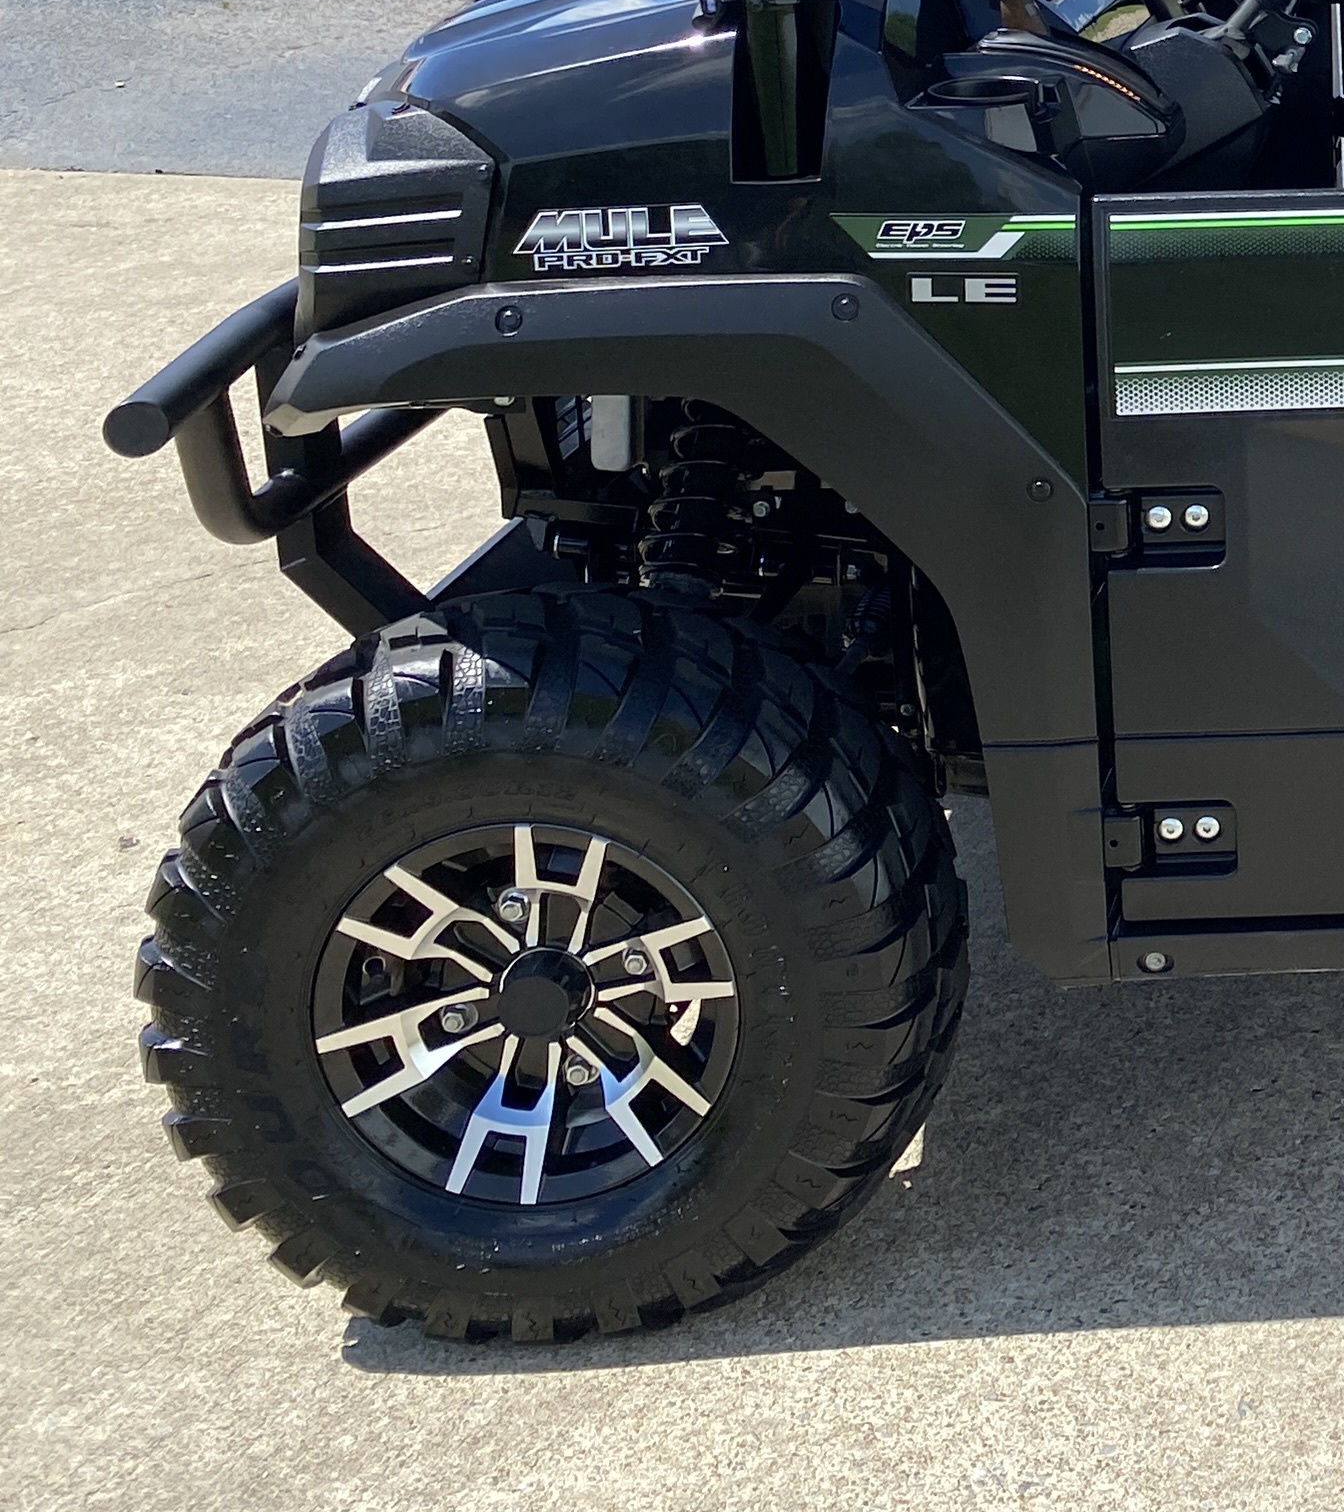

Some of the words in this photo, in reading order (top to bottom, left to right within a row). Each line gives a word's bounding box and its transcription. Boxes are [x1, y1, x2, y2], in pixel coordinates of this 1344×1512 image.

[513, 203, 730, 255] MULE
[533, 246, 711, 271] PRO-FXT
[911, 278, 1017, 303] LE
